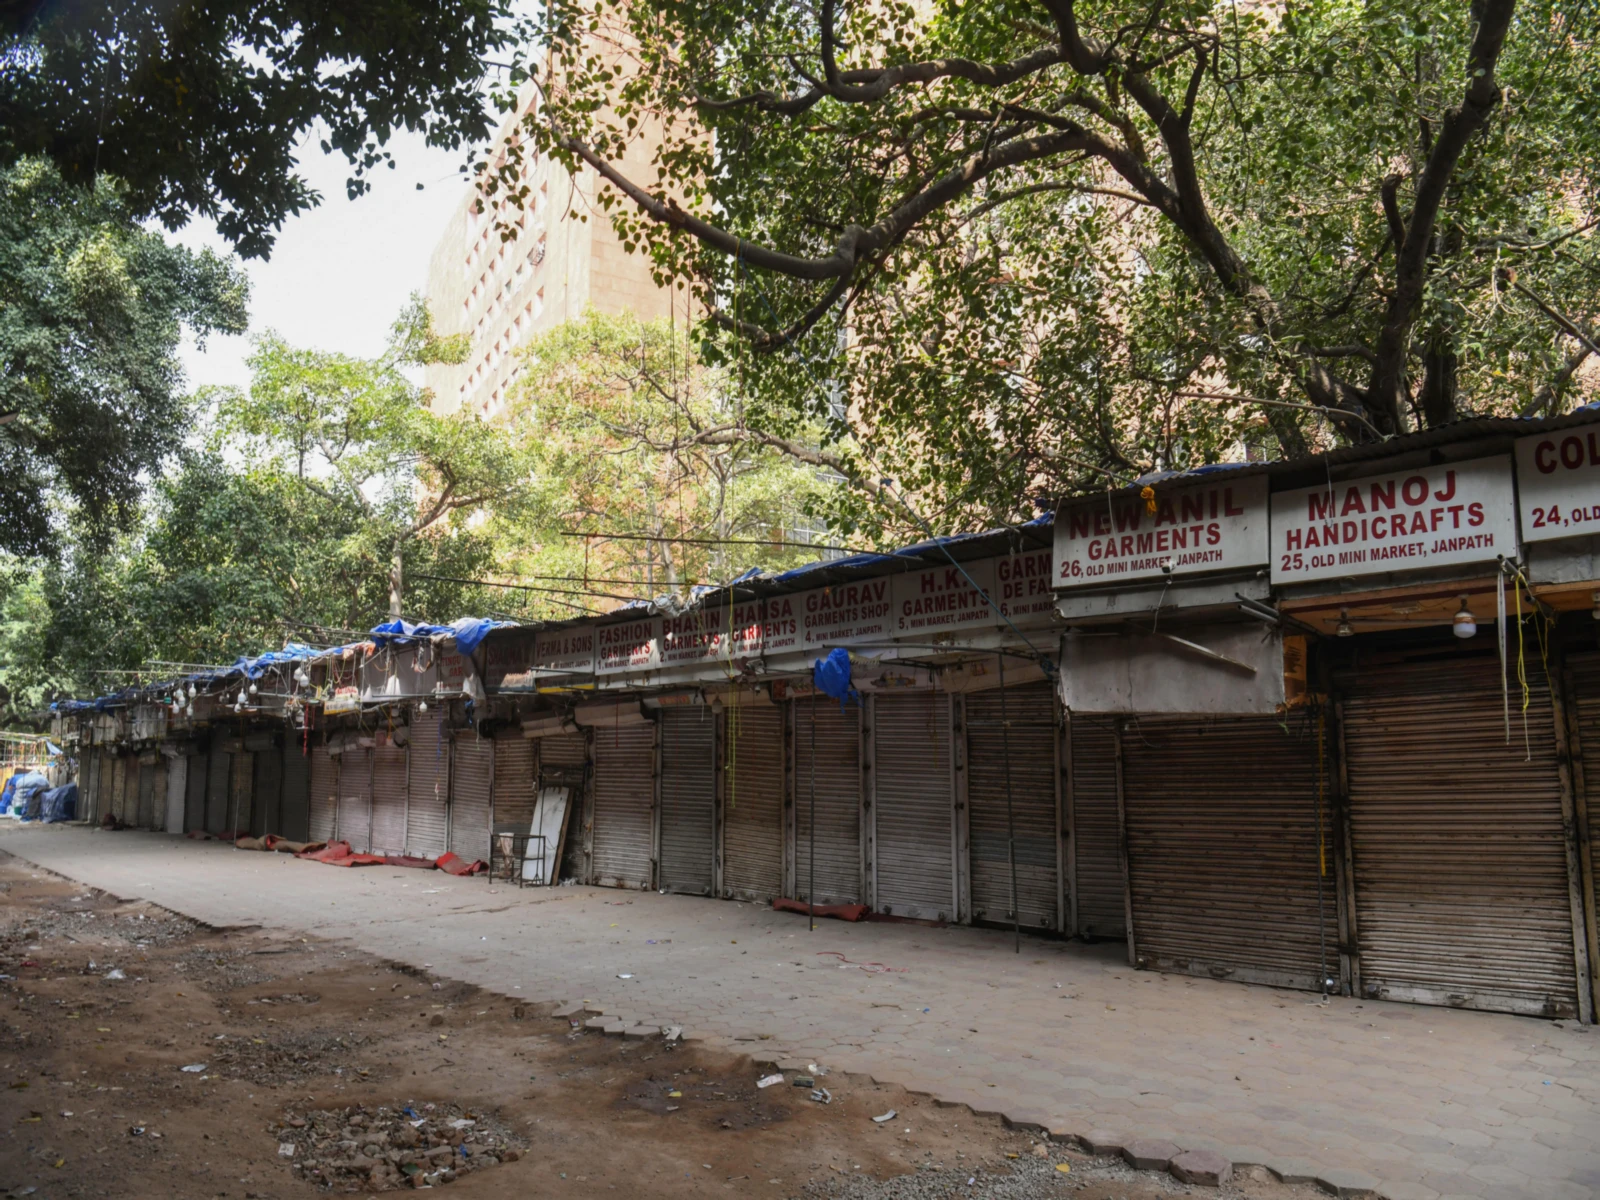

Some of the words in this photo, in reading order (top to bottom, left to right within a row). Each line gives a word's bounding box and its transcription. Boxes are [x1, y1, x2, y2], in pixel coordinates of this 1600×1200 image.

[1308, 470, 1456, 521] MANOJ
[1070, 502, 1142, 540] NEW
[1154, 487, 1244, 528] ANIL
[1532, 505, 1569, 528] 24,
[1286, 502, 1485, 551] HANDICRAFTS
[1088, 523, 1221, 560] GARMENTS
[1281, 553, 1309, 572] 25,
[1311, 554, 1335, 568] OLD
[1339, 549, 1366, 565] MINI
[1371, 542, 1427, 561] MARKET,
[1431, 533, 1494, 554] JANPATH
[1060, 560, 1084, 578] 26,
[1086, 564, 1104, 576] OLD
[1107, 561, 1128, 574] MINI
[1177, 549, 1223, 566] JANPATH
[921, 568, 968, 593] H.K.
[1004, 581, 1023, 599] DE
[806, 581, 886, 613] GAURAV
[903, 588, 989, 616] GARMENTS
[734, 599, 793, 625] HANSA
[804, 608, 858, 629] GARMENTS
[861, 603, 889, 620] SHOP
[898, 617, 908, 630] 5,
[911, 618, 925, 628] MINI
[927, 614, 956, 625] MARKET,
[958, 610, 989, 621] JANPATH
[1013, 605, 1030, 616] MINI
[599, 622, 652, 644] FASHION
[662, 611, 720, 636] BHASIN
[732, 619, 797, 642] GARMENTS
[816, 631, 828, 641] MINI
[856, 625, 882, 636] JANPATH
[536, 638, 561, 658] VERMA
[563, 638, 568, 655] &
[571, 635, 592, 654] SONS
[601, 640, 650, 659] GARMENTS
[663, 631, 720, 651] GARMENTS
[772, 638, 796, 649] JANPATH
